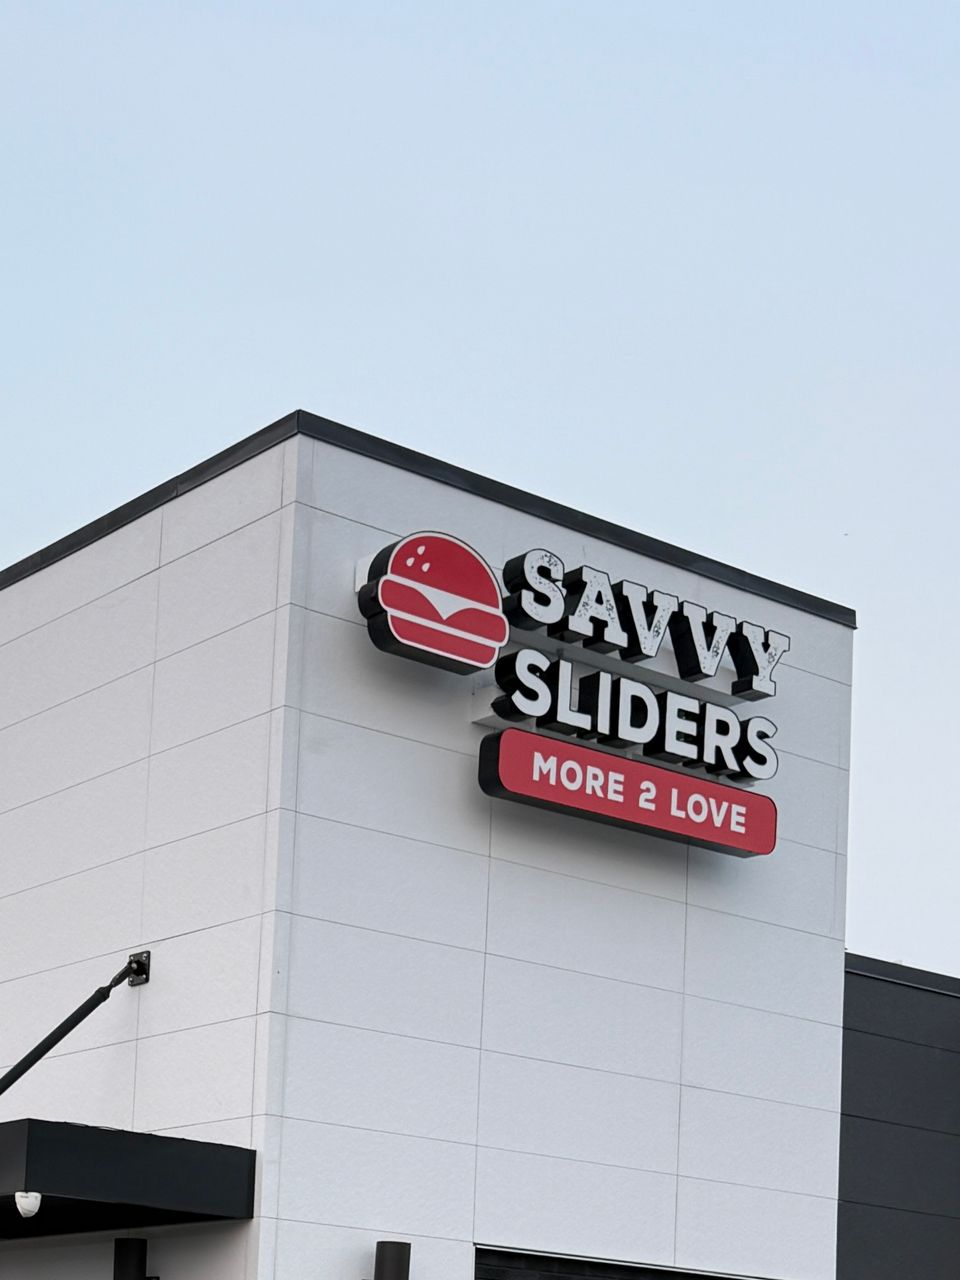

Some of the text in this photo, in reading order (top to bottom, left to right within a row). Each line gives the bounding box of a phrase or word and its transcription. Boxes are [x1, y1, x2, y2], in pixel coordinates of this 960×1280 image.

[520, 548, 791, 697] SAVVY
[510, 648, 779, 780] SLIDERS
[533, 751, 747, 834] MORE 2 LOVE
